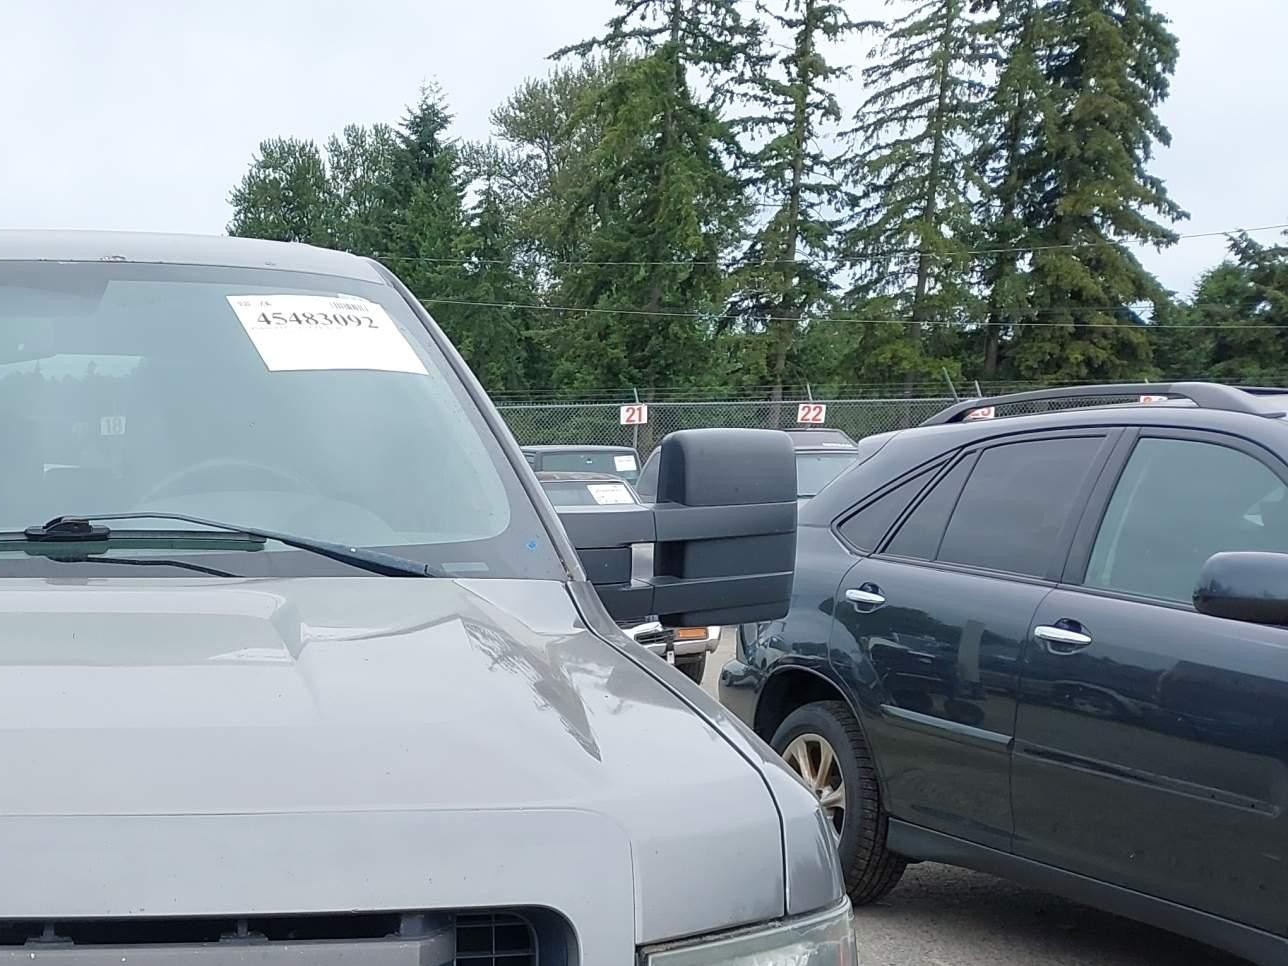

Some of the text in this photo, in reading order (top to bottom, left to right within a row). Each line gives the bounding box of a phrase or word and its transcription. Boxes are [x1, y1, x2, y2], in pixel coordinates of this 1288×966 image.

[256, 311, 380, 330] 45483092
[625, 406, 643, 423] 21
[800, 405, 823, 422] 22
[105, 418, 123, 433] 18
